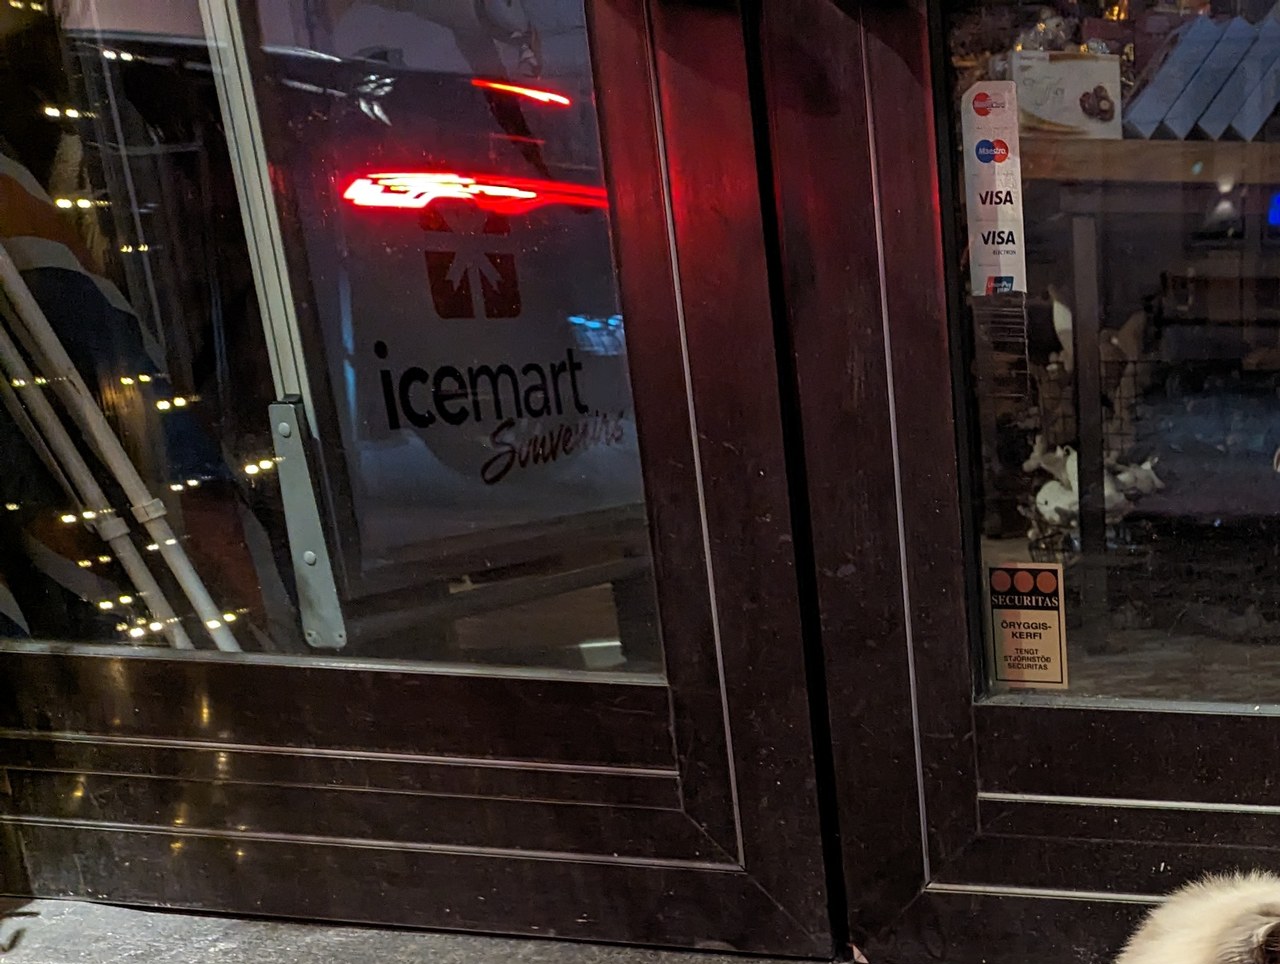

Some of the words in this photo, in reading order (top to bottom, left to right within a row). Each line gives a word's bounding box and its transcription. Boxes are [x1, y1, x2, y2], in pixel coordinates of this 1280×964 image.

[979, 190, 1014, 206] VISA
[981, 230, 1015, 245] VISA
[374, 340, 589, 430] icemart
[992, 595, 1058, 607] SECURITAS
[1001, 620, 1052, 630] ÖRYGGIS-
[1011, 631, 1042, 640] KERFI
